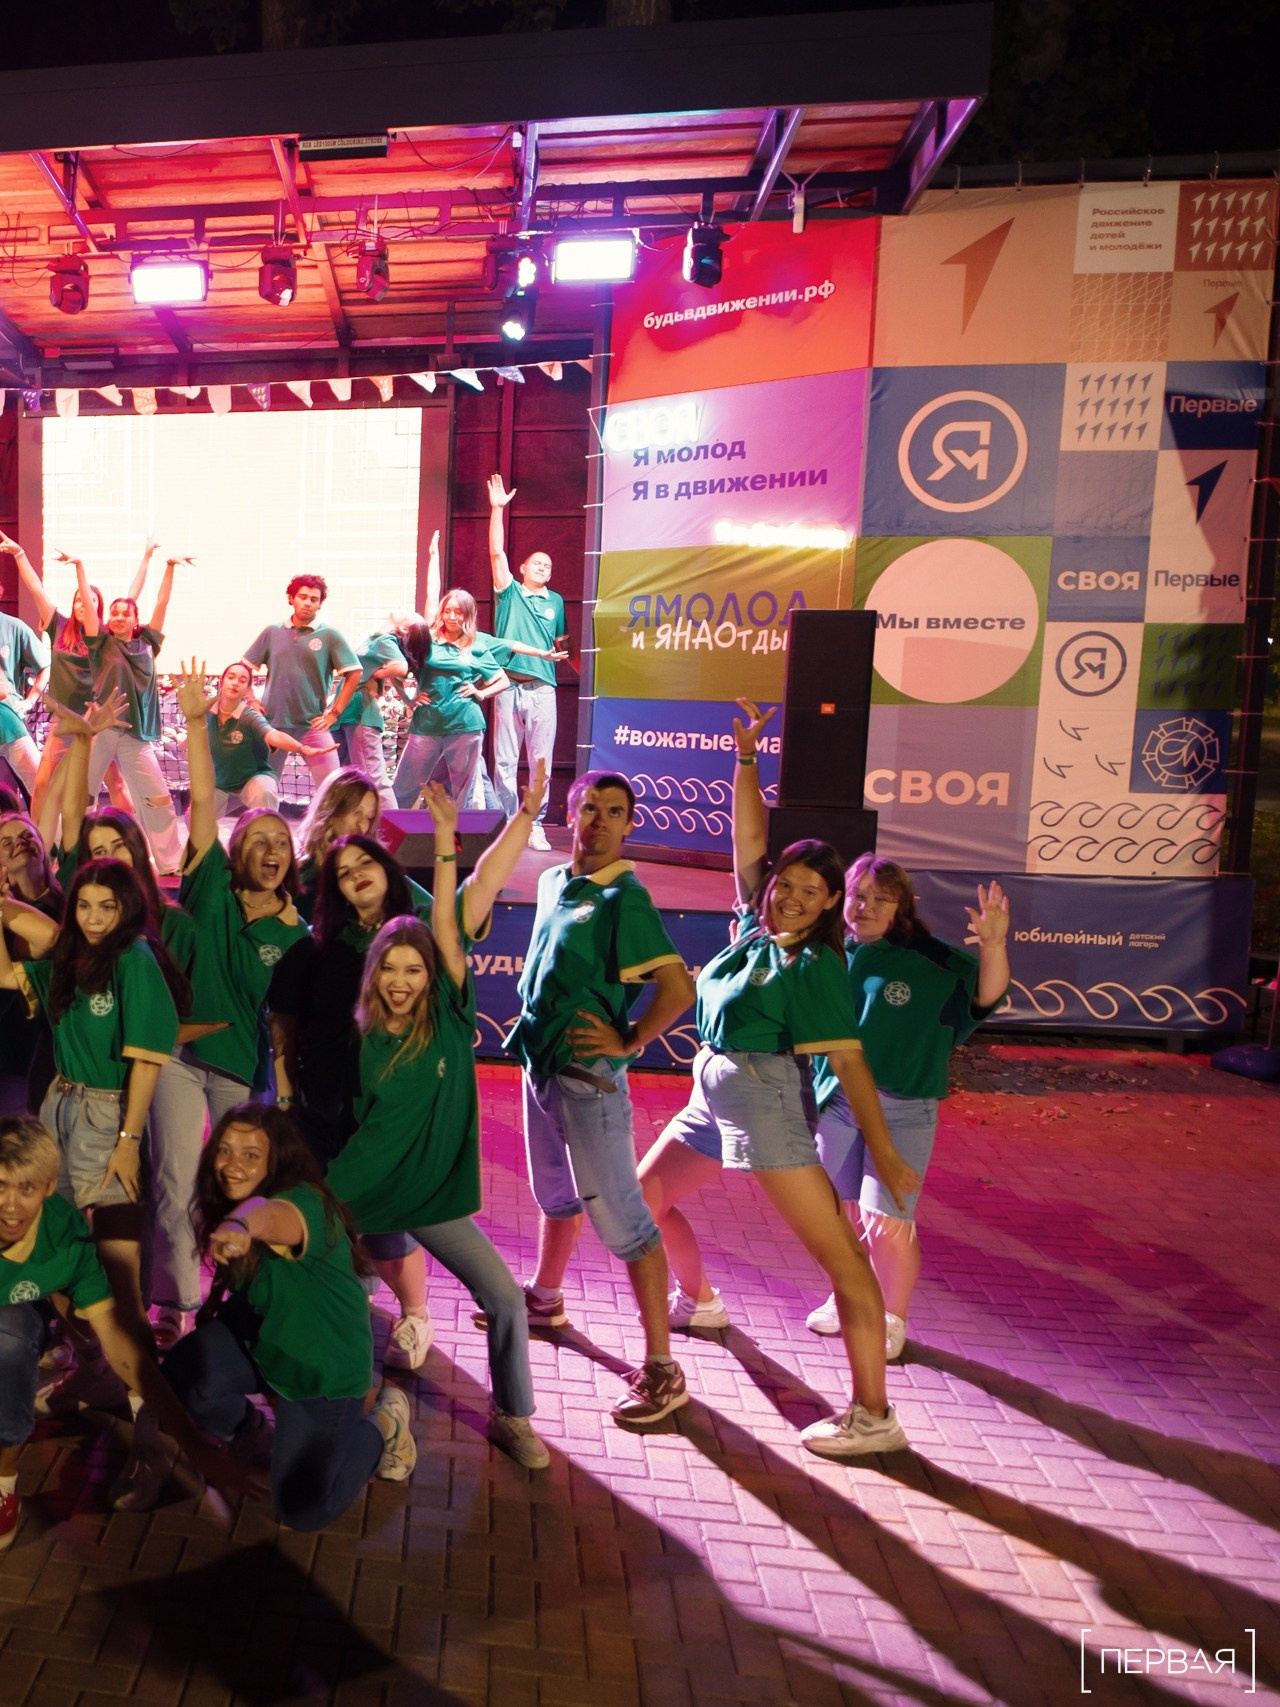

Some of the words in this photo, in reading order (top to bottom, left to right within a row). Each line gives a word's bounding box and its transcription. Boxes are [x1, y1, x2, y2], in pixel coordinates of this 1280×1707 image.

[1092, 207, 1165, 216] Российское
[1091, 219, 1152, 228] движение
[1090, 231, 1125, 240] детей
[1099, 241, 1163, 251] молодёжи
[643, 279, 836, 329] будьвдвижении.рф
[1169, 394, 1258, 419] Первые
[632, 447, 649, 467] Я
[656, 440, 746, 465] молод
[632, 480, 649, 501] Я
[655, 483, 669, 499] в
[674, 468, 828, 501] движении
[1056, 570, 1141, 592] СВОЯ
[1154, 569, 1240, 593] Первые
[874, 613, 919, 630] Мы
[926, 616, 1026, 631] вместе
[631, 631, 645, 650] и
[655, 616, 787, 655] ЯНАОтды
[863, 768, 1011, 807] СВОЯ
[1014, 926, 1123, 947] юбилейный
[1129, 932, 1167, 942] детский
